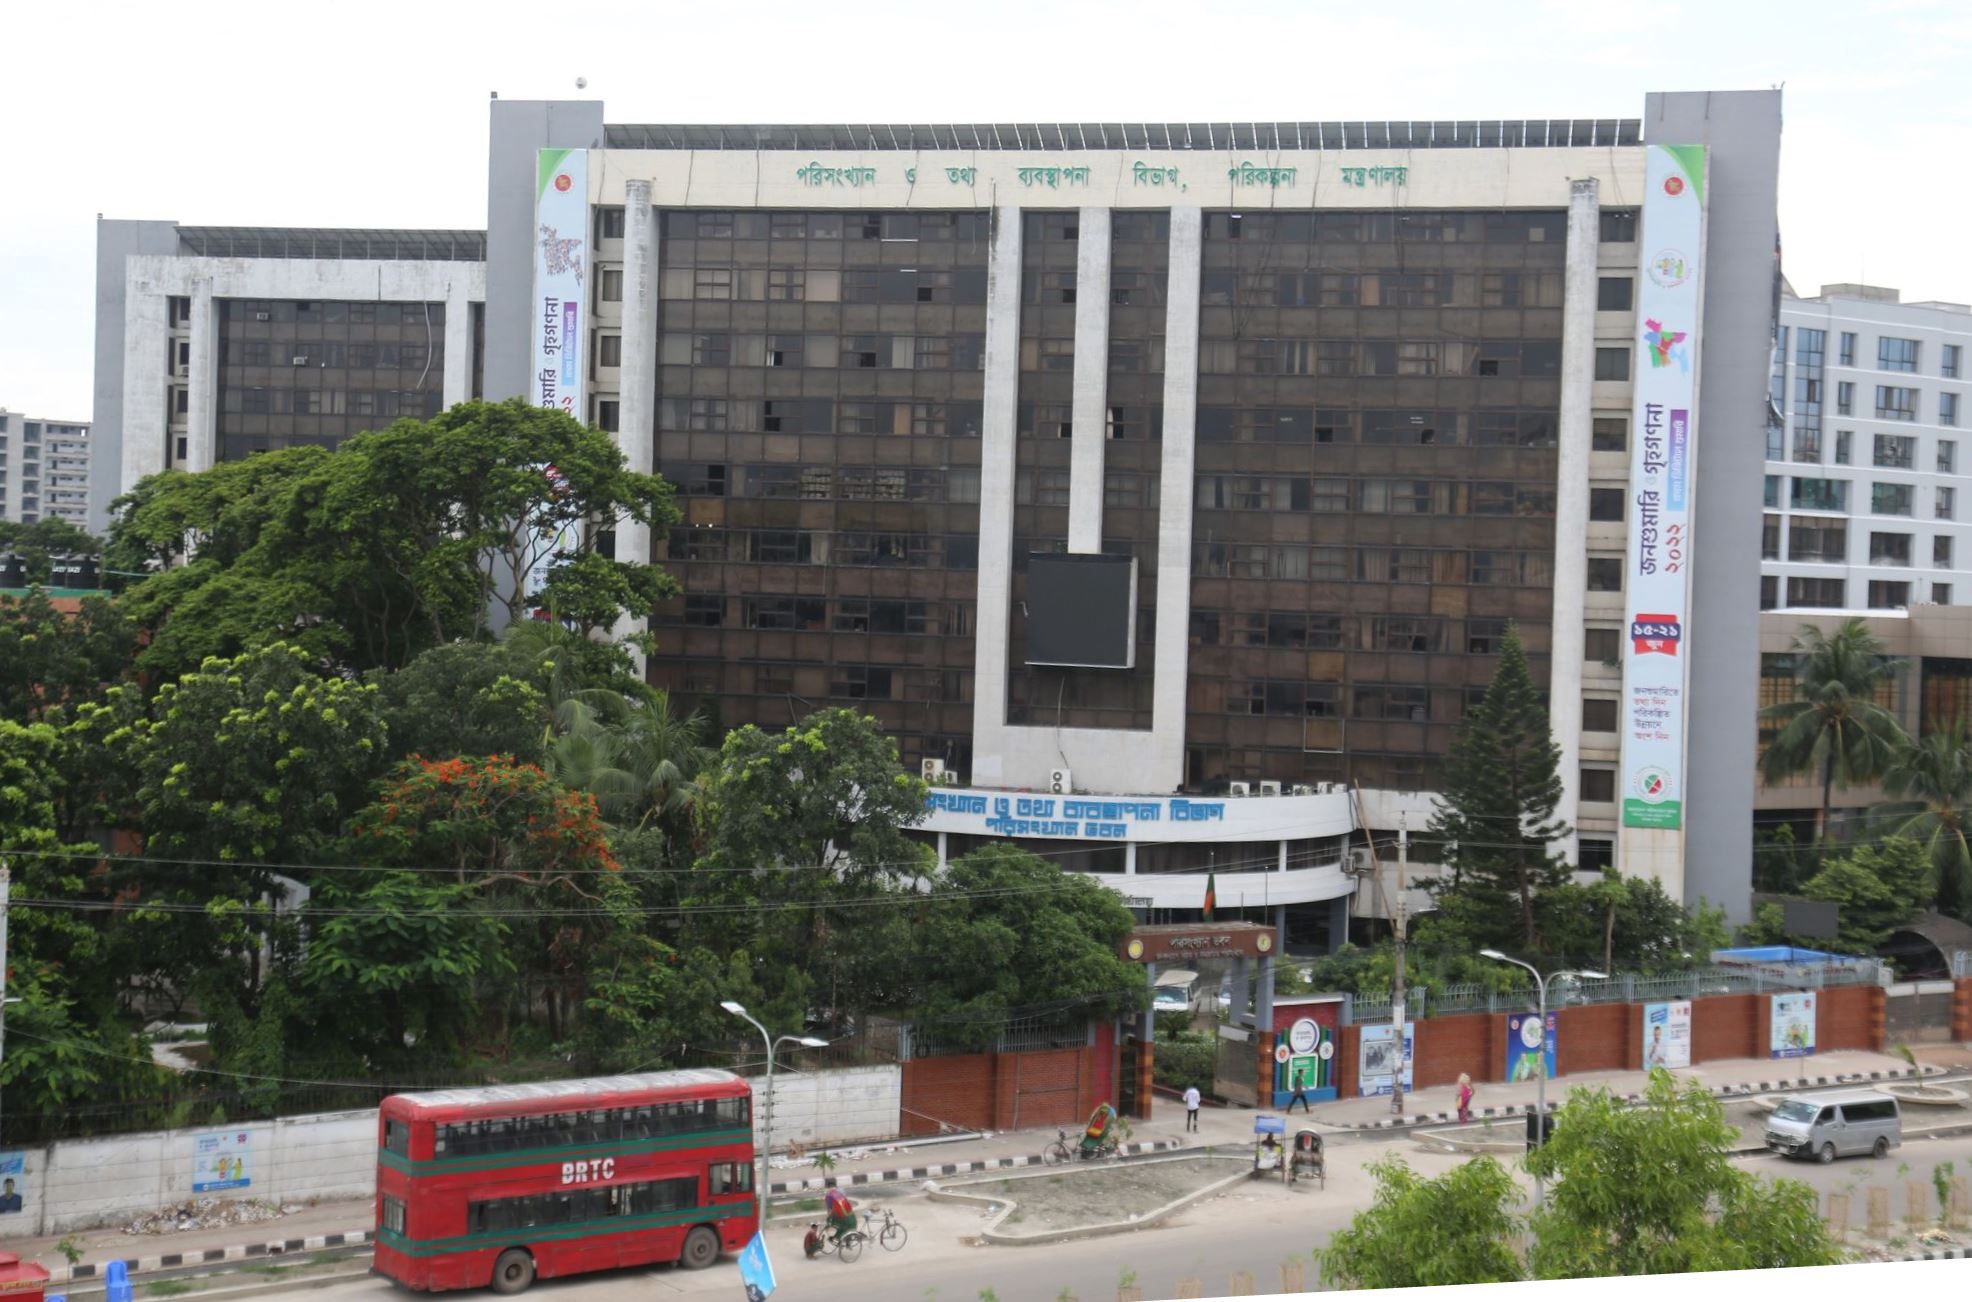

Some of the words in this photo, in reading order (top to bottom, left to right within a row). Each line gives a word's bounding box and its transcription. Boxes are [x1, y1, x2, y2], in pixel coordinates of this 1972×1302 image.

[796, 161, 876, 187] পরিসংখ্যান
[904, 166, 917, 186] ও
[946, 166, 978, 187] তথ্য
[1018, 165, 1091, 189] ব্যবস্থাপনা
[1227, 161, 1297, 188] পরিকল্পনা
[1340, 165, 1408, 188] মন্ত্রণালয়
[1642, 403, 1668, 475] গৃহগণনা
[1636, 489, 1660, 576] জনশুমারি
[1664, 523, 1686, 574] ২০২২
[1634, 624, 1678, 637] ১৫-২১
[1017, 798, 1055, 818] তথ্য
[1062, 799, 1162, 821] ব্যবস্থাপনা
[1169, 799, 1226, 821] বিভাগ
[985, 816, 1079, 837] পরিসংখ্যান
[1084, 821, 1128, 838] ভবন
[562, 1158, 615, 1184] BRTC
